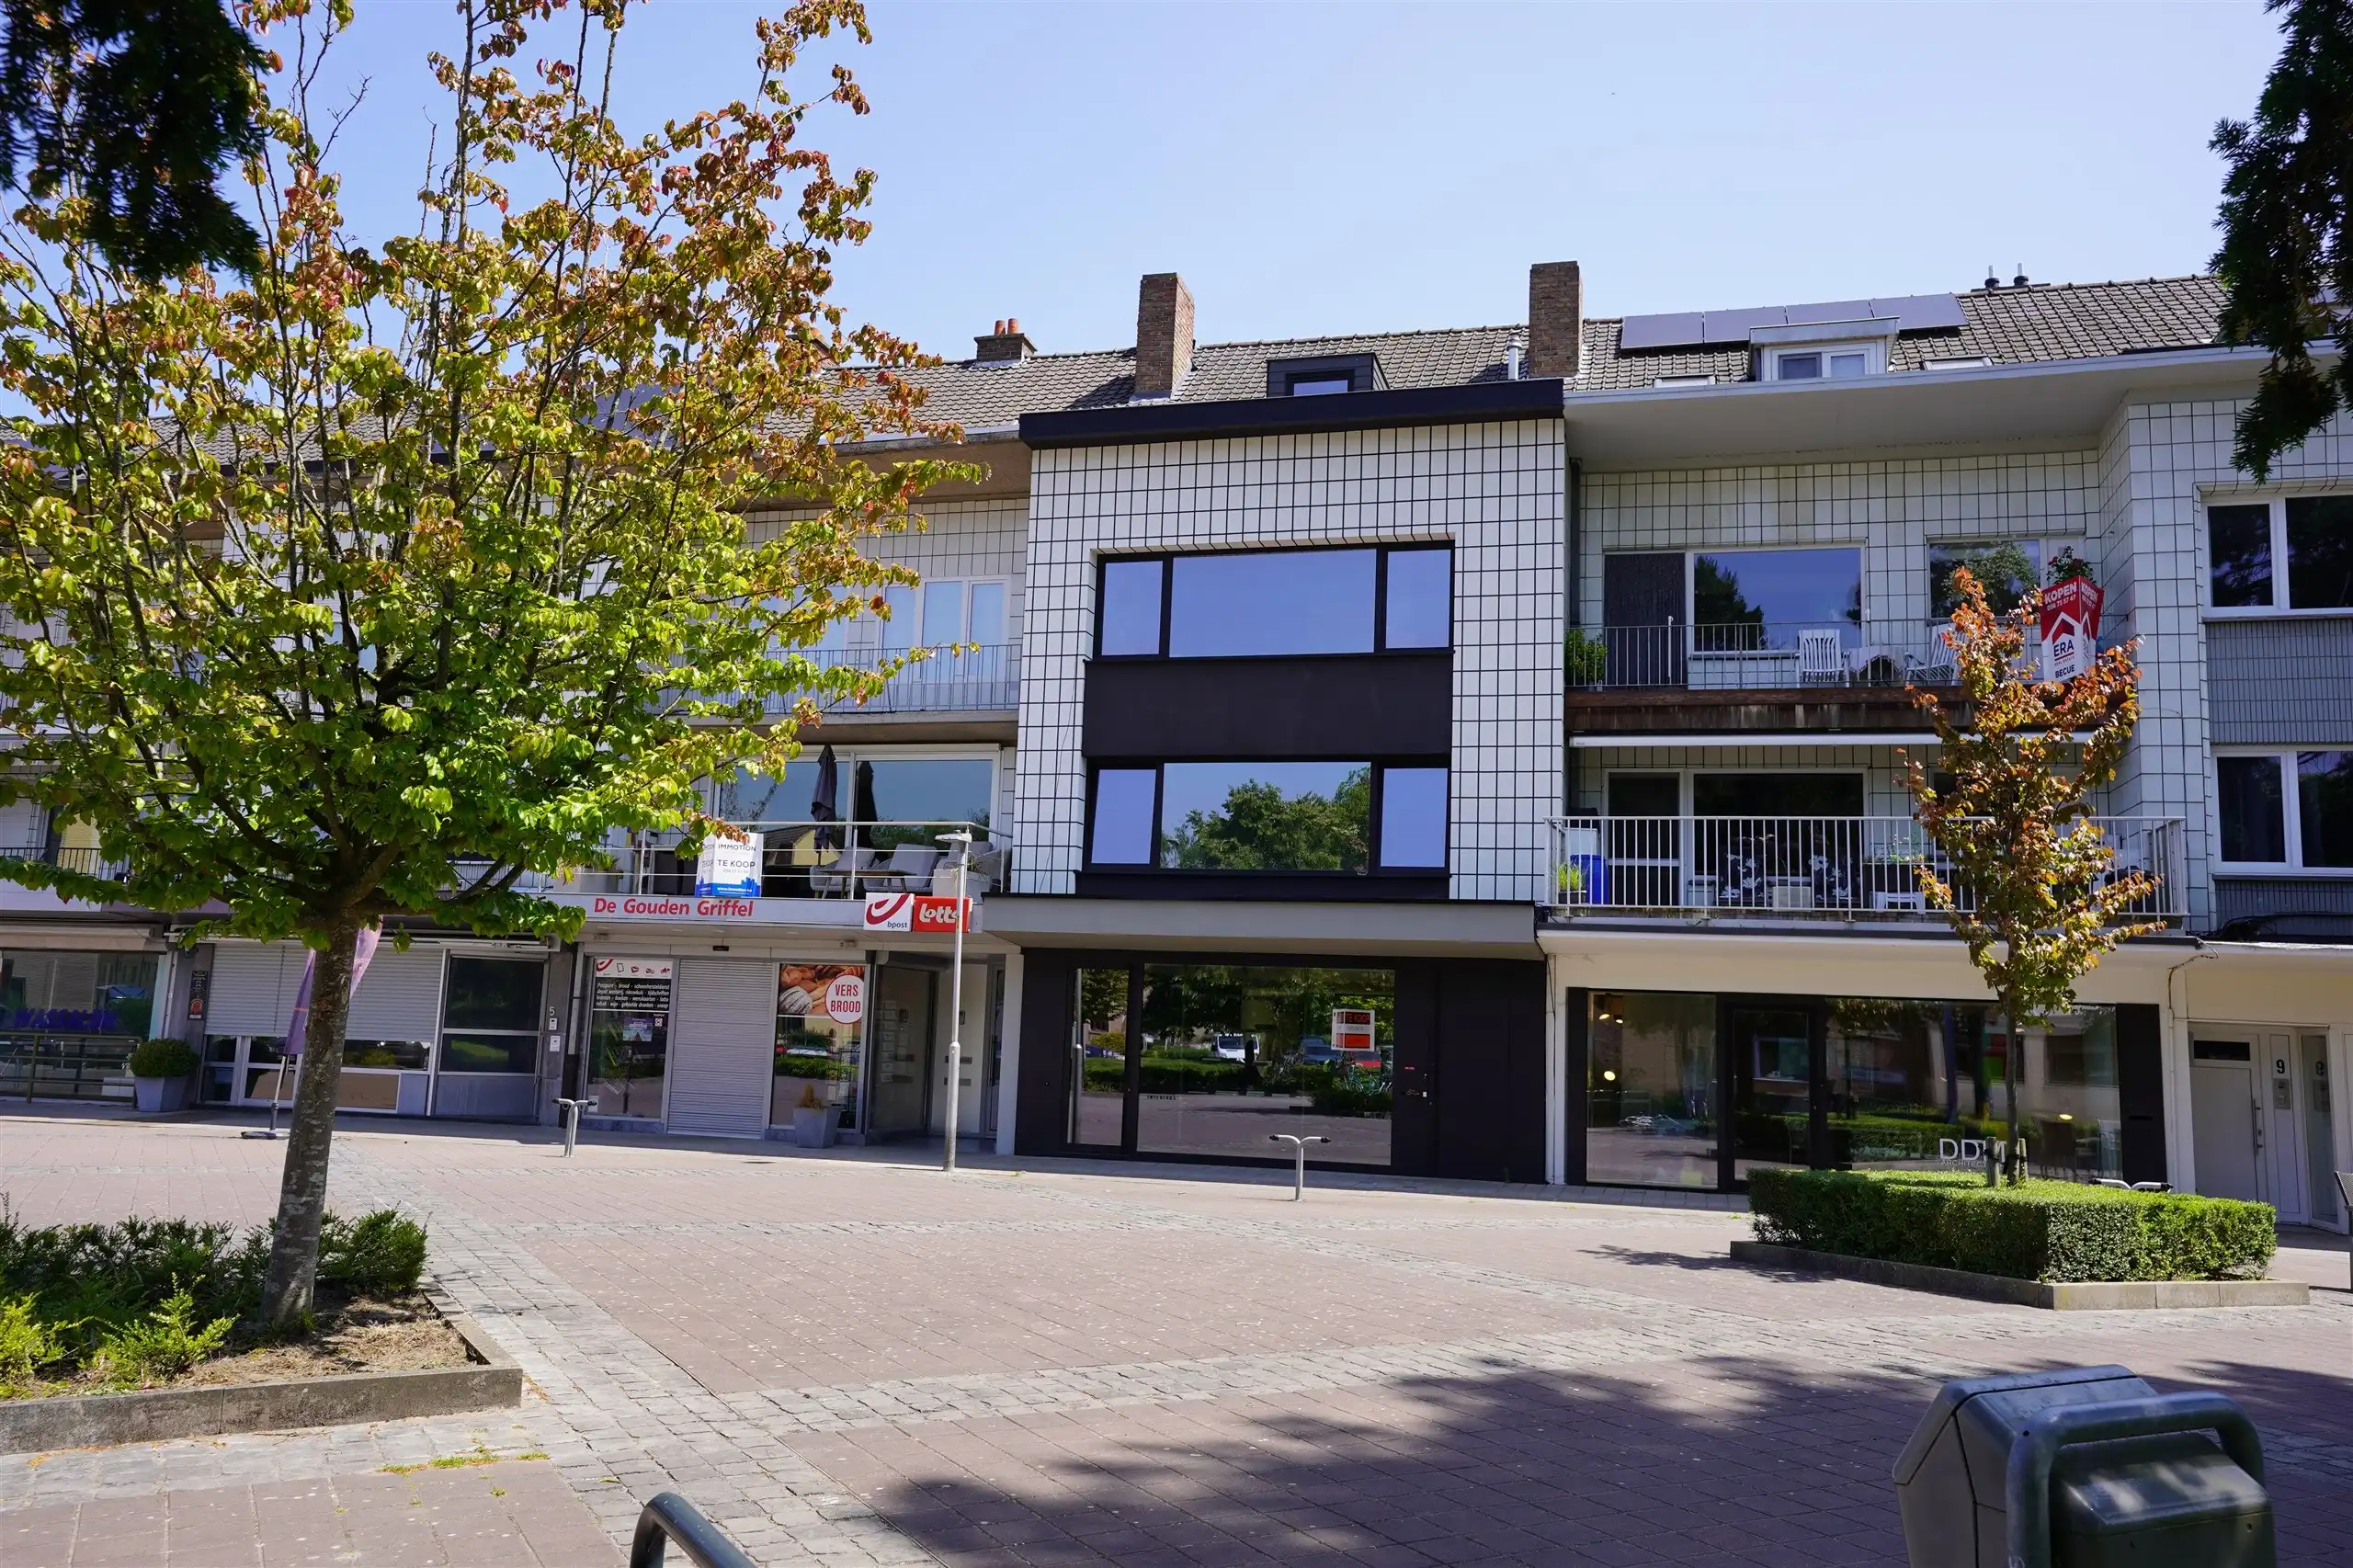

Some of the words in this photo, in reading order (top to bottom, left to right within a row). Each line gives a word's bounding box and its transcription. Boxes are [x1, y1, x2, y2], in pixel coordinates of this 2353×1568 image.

[2044, 582, 2077, 605] KOPEN
[2053, 640, 2075, 657] ERA
[2055, 665, 2075, 678] BECUE
[594, 898, 617, 914] De
[623, 899, 689, 915] Gouden
[697, 900, 754, 916] Griffel
[835, 984, 858, 997] VERS
[549, 1006, 555, 1017] 5
[831, 1000, 861, 1013] BROOD
[2276, 1059, 2285, 1074] 9
